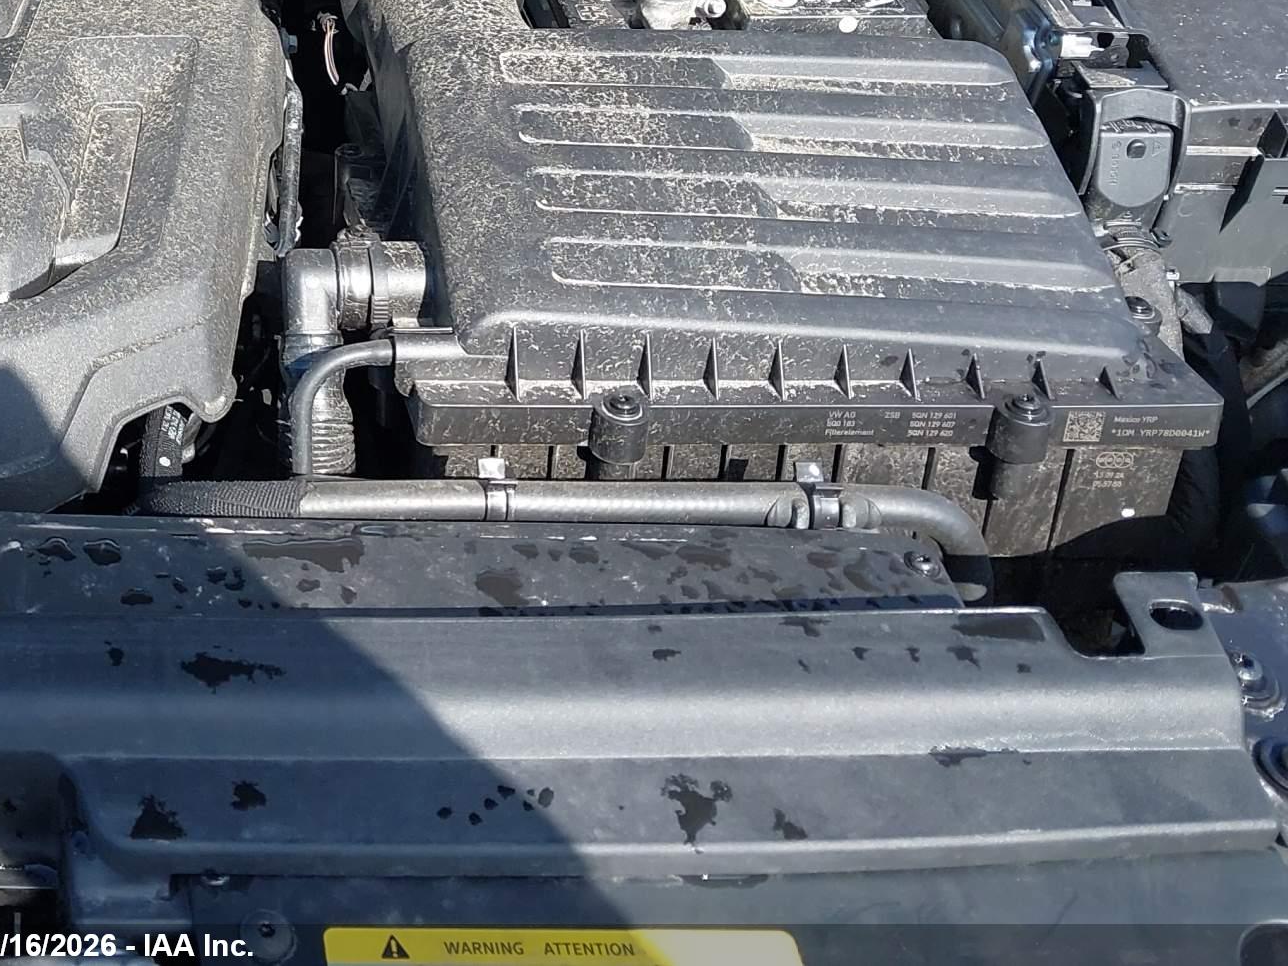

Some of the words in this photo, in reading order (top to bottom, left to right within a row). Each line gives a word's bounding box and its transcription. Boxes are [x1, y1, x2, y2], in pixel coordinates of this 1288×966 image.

[1113, 415, 1142, 423] Mexico
[443, 940, 525, 956] WARNING
[543, 940, 635, 957] ATTENTION
